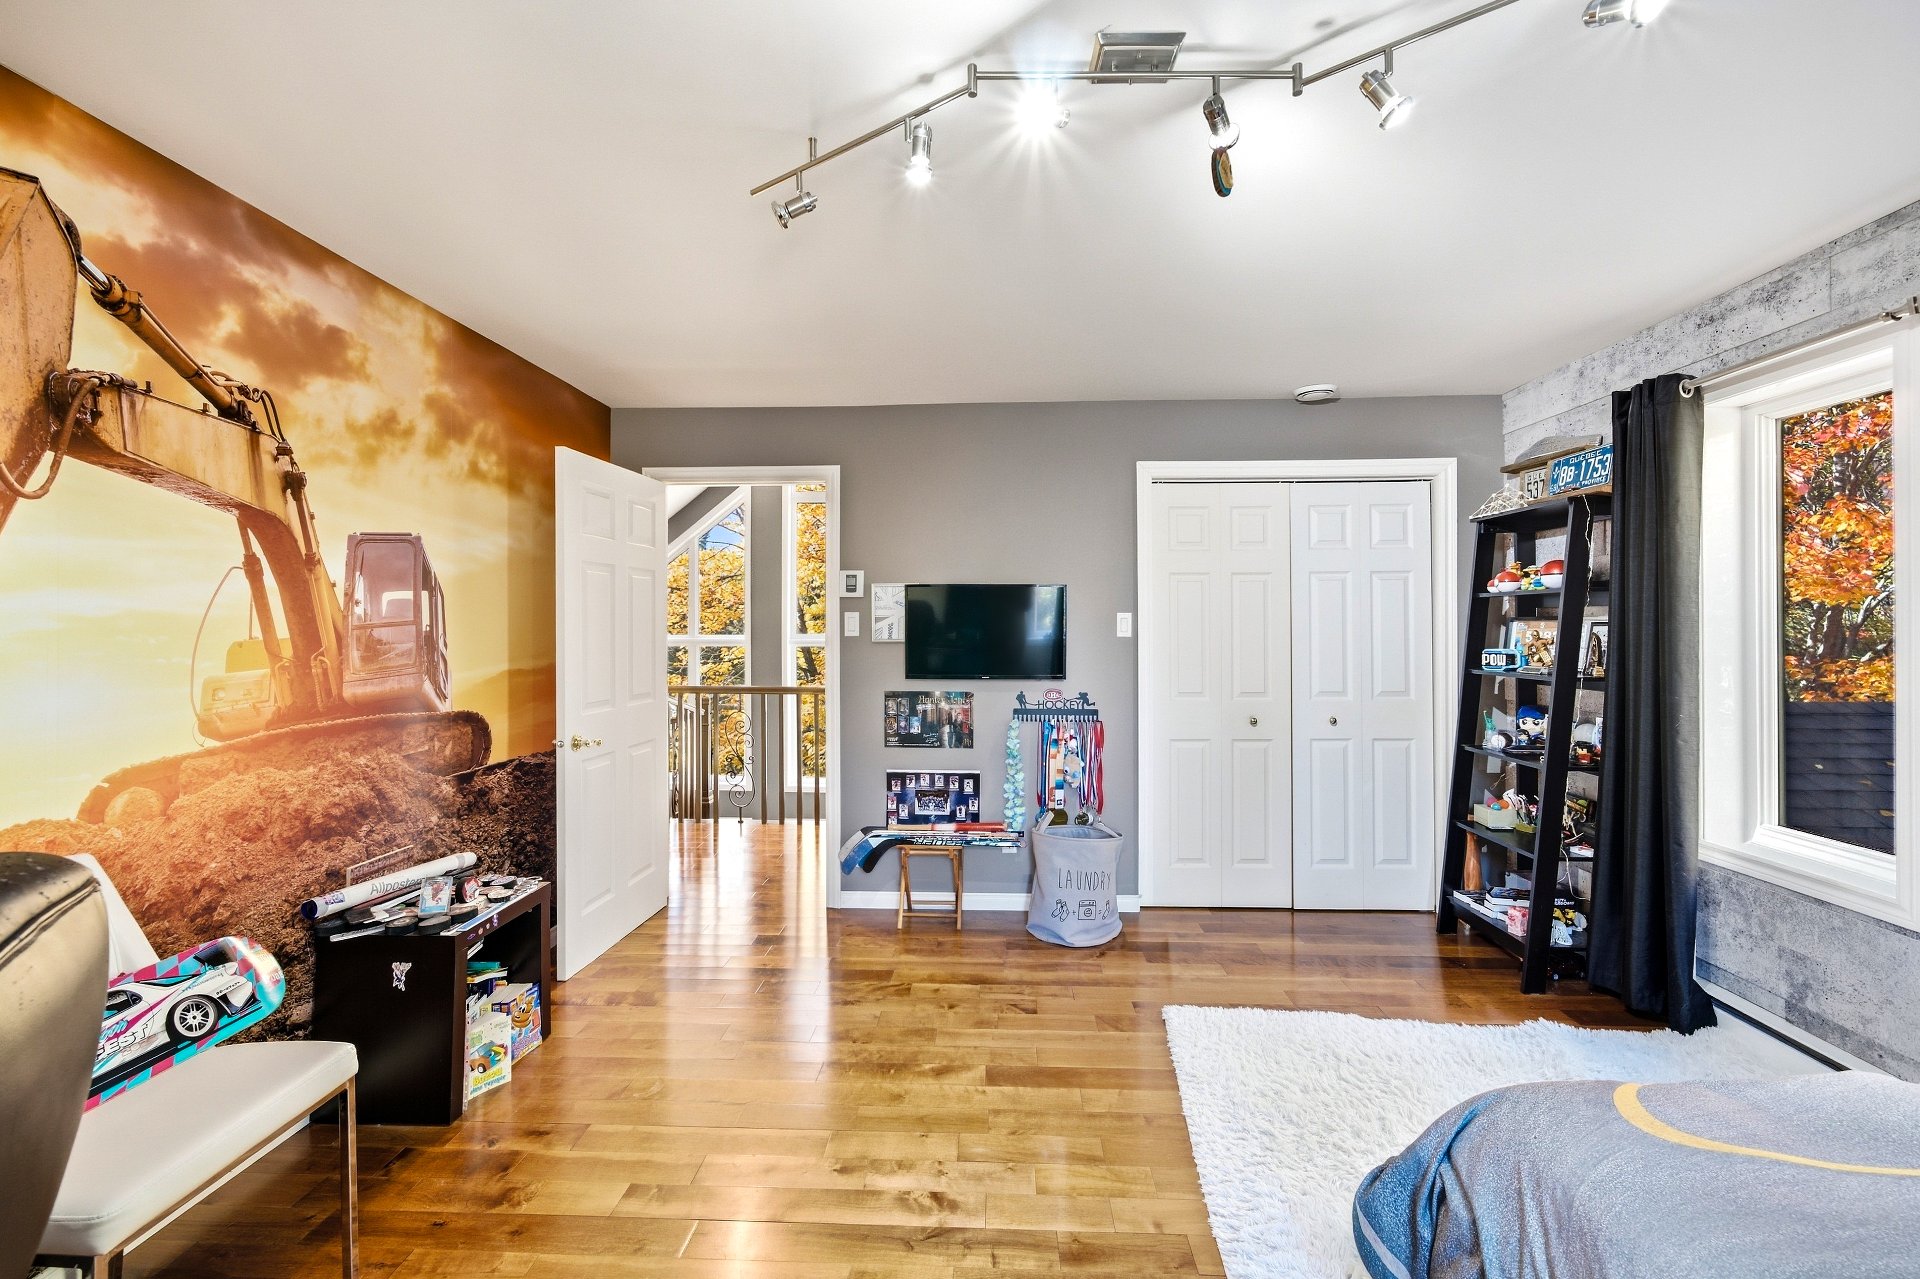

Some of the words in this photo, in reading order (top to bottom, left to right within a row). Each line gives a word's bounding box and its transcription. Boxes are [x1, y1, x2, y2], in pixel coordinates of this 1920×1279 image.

[1526, 479, 1545, 499] 537
[1481, 653, 1507, 666] POW
[1037, 699, 1081, 710] HOCKEY
[370, 877, 425, 895] Allposter
[1058, 867, 1111, 891] LAUNDRY
